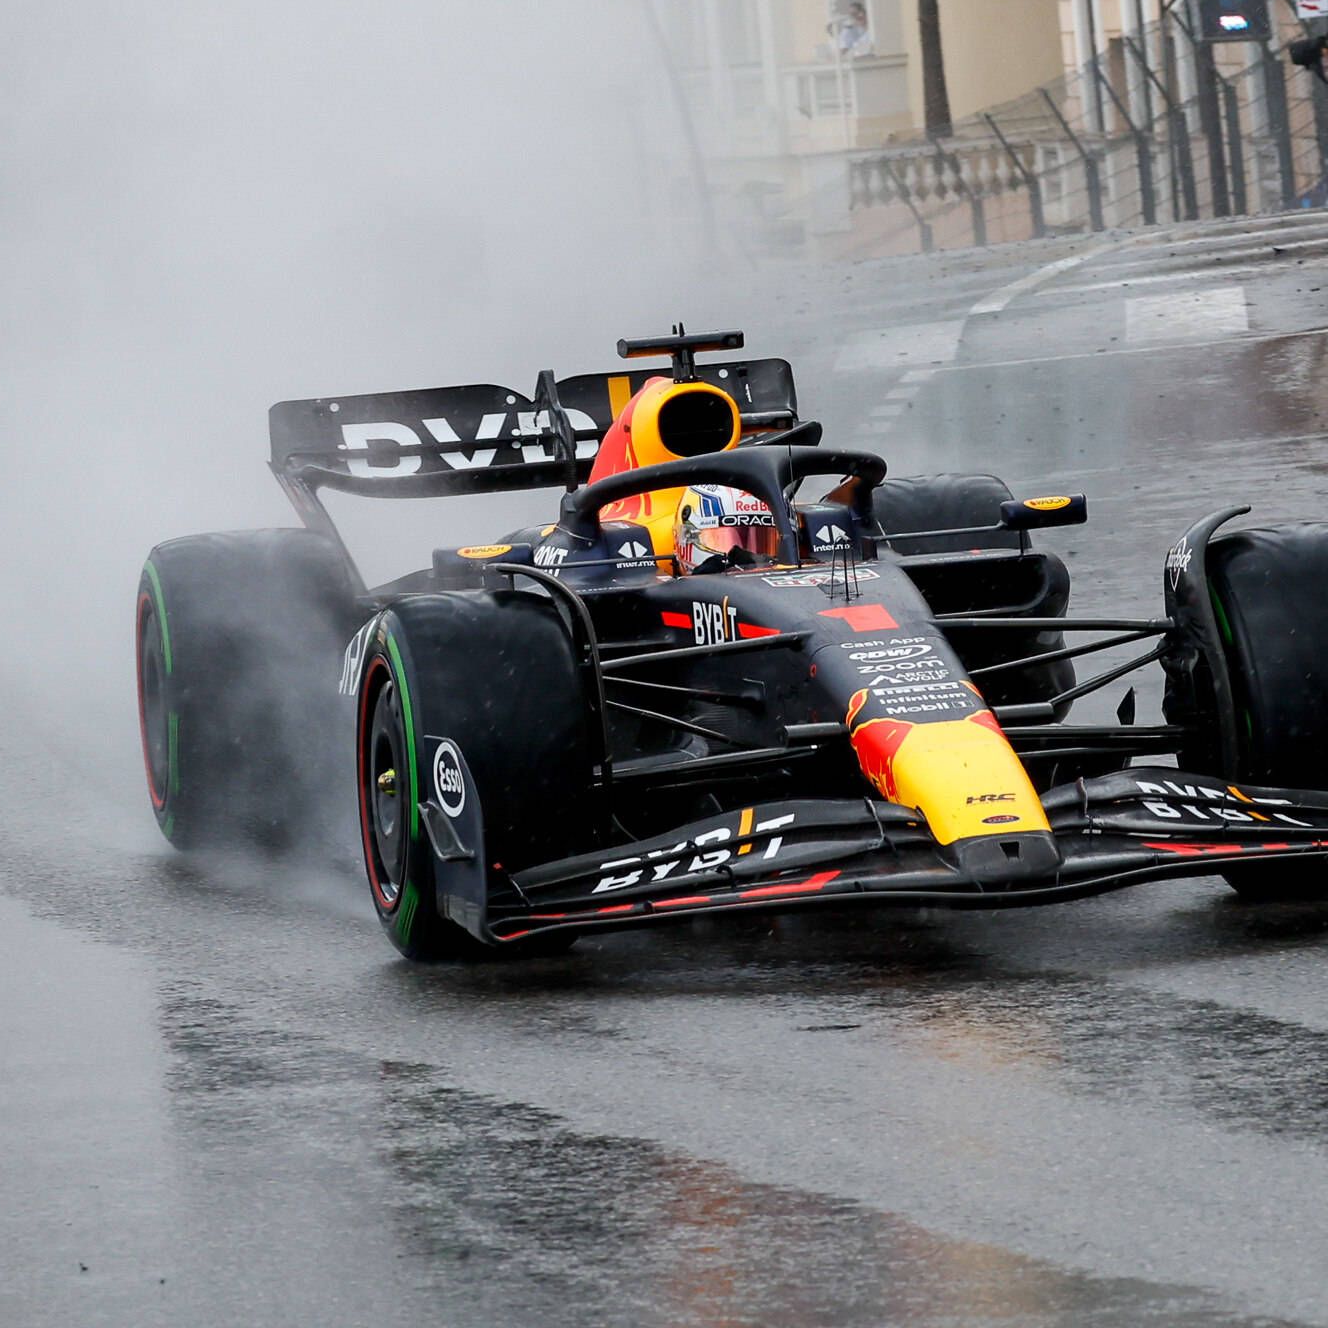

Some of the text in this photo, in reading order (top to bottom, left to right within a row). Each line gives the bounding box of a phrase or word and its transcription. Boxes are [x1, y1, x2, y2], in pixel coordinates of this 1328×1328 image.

[736, 500, 758, 511] Red
[722, 515, 777, 527] ORACL
[692, 595, 738, 646] BYBIT
[840, 636, 926, 649] Cash App
[849, 648, 914, 660] CDW
[856, 659, 945, 674] zoom
[895, 669, 950, 679] ARCTIC
[904, 673, 948, 682] WOLF
[872, 681, 960, 697] PIRELLI
[885, 702, 950, 715] Mobil
[439, 760, 463, 794] Esso
[966, 793, 1017, 804] HRC
[592, 808, 796, 885] BYBIT
